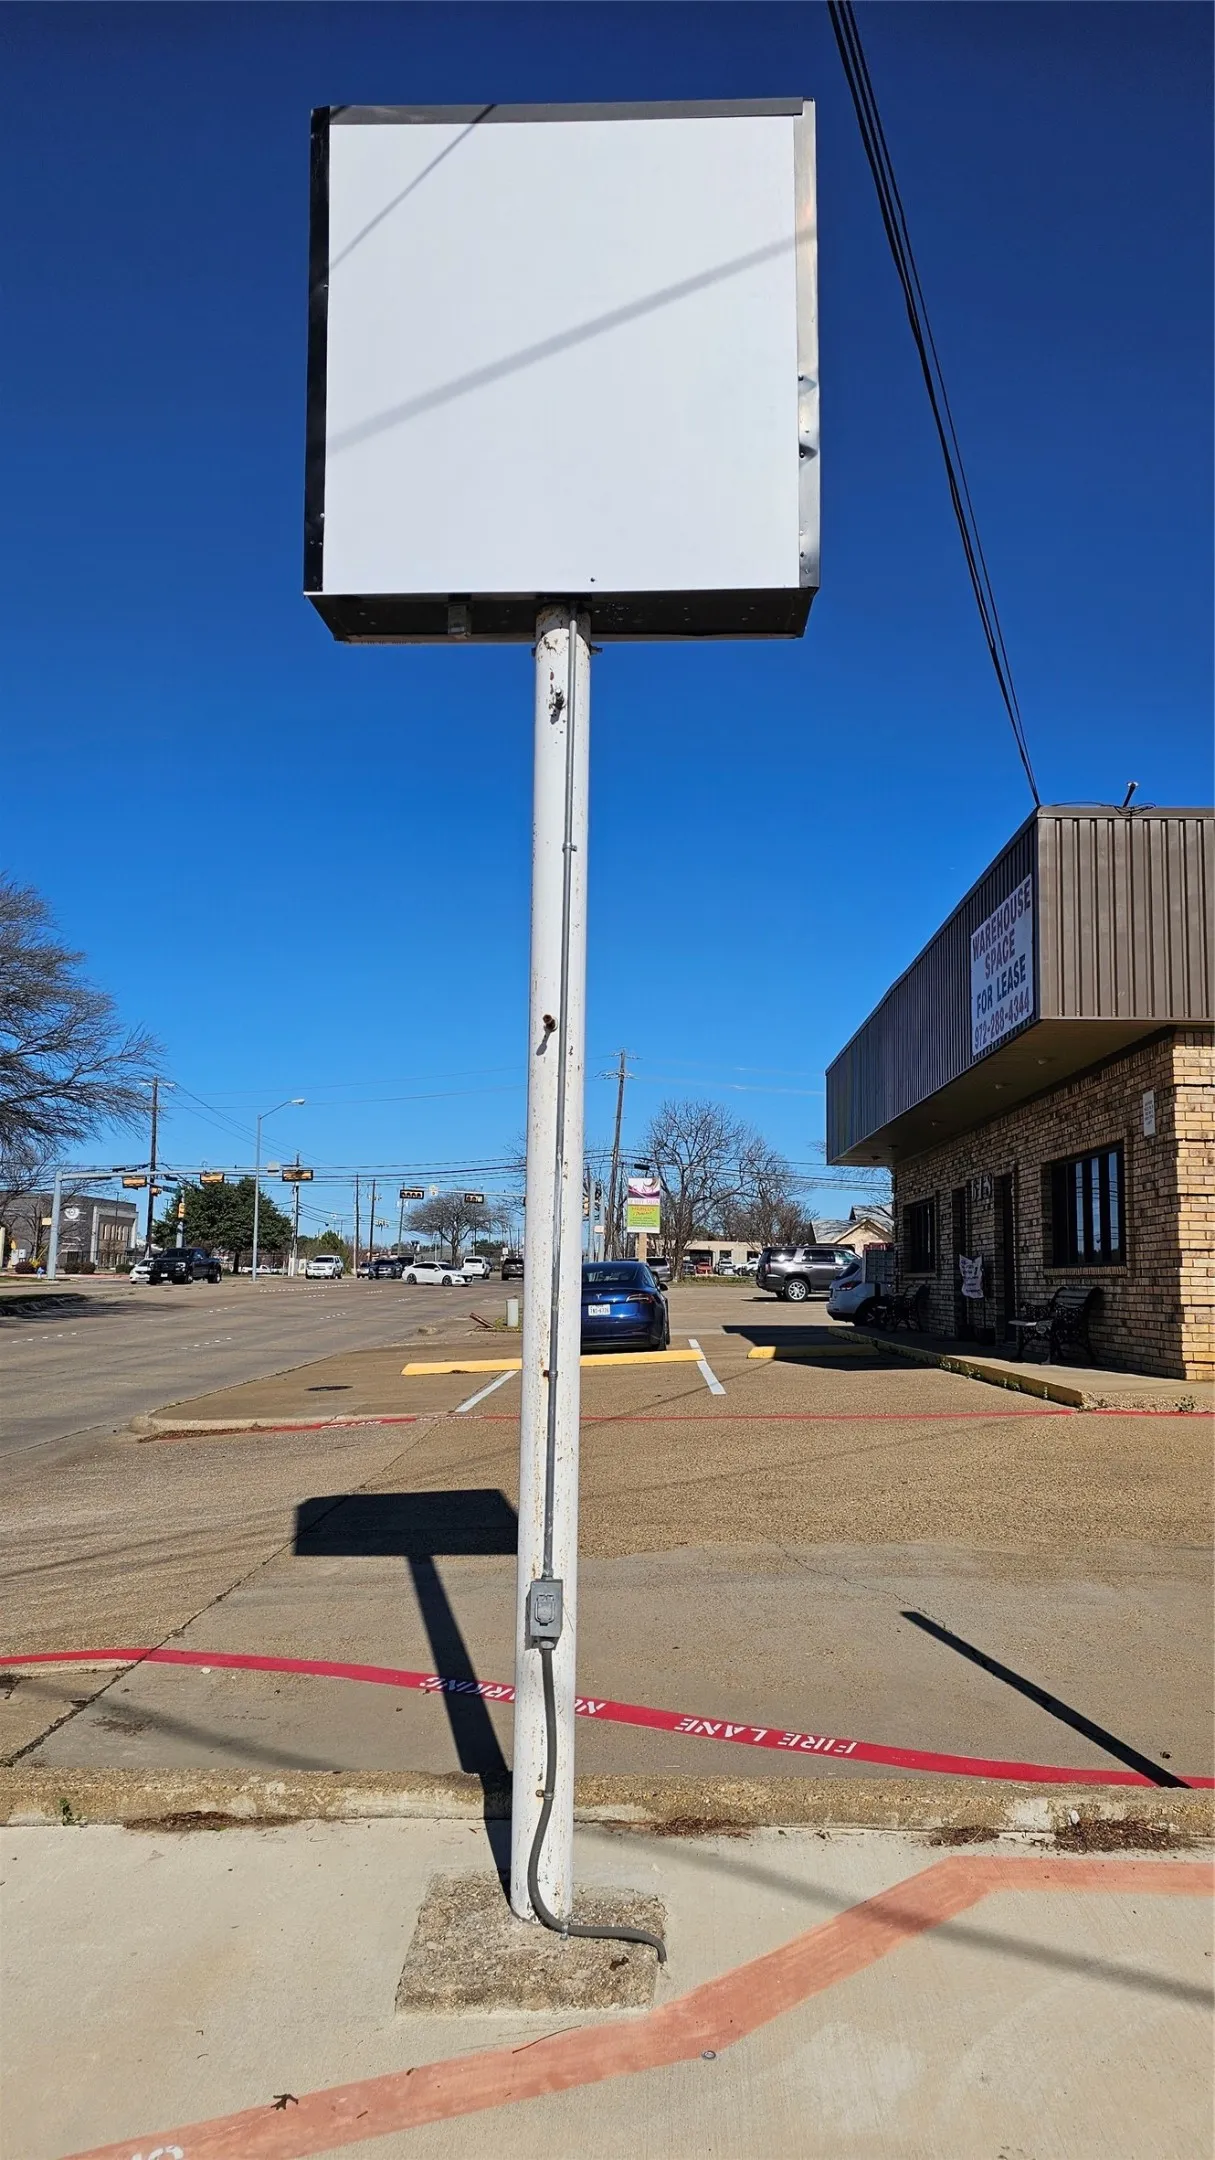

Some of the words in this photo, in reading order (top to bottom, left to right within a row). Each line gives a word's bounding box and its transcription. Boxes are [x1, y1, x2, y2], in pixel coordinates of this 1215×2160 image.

[972, 878, 1031, 962] WAREHOUSE
[985, 928, 1015, 980] SPACE
[976, 984, 993, 1019] FOR
[997, 953, 1026, 1002] LEASE
[420, 1676, 516, 1701] RKING
[674, 1717, 768, 1742] LANE
[777, 1732, 858, 1754] FIRE
